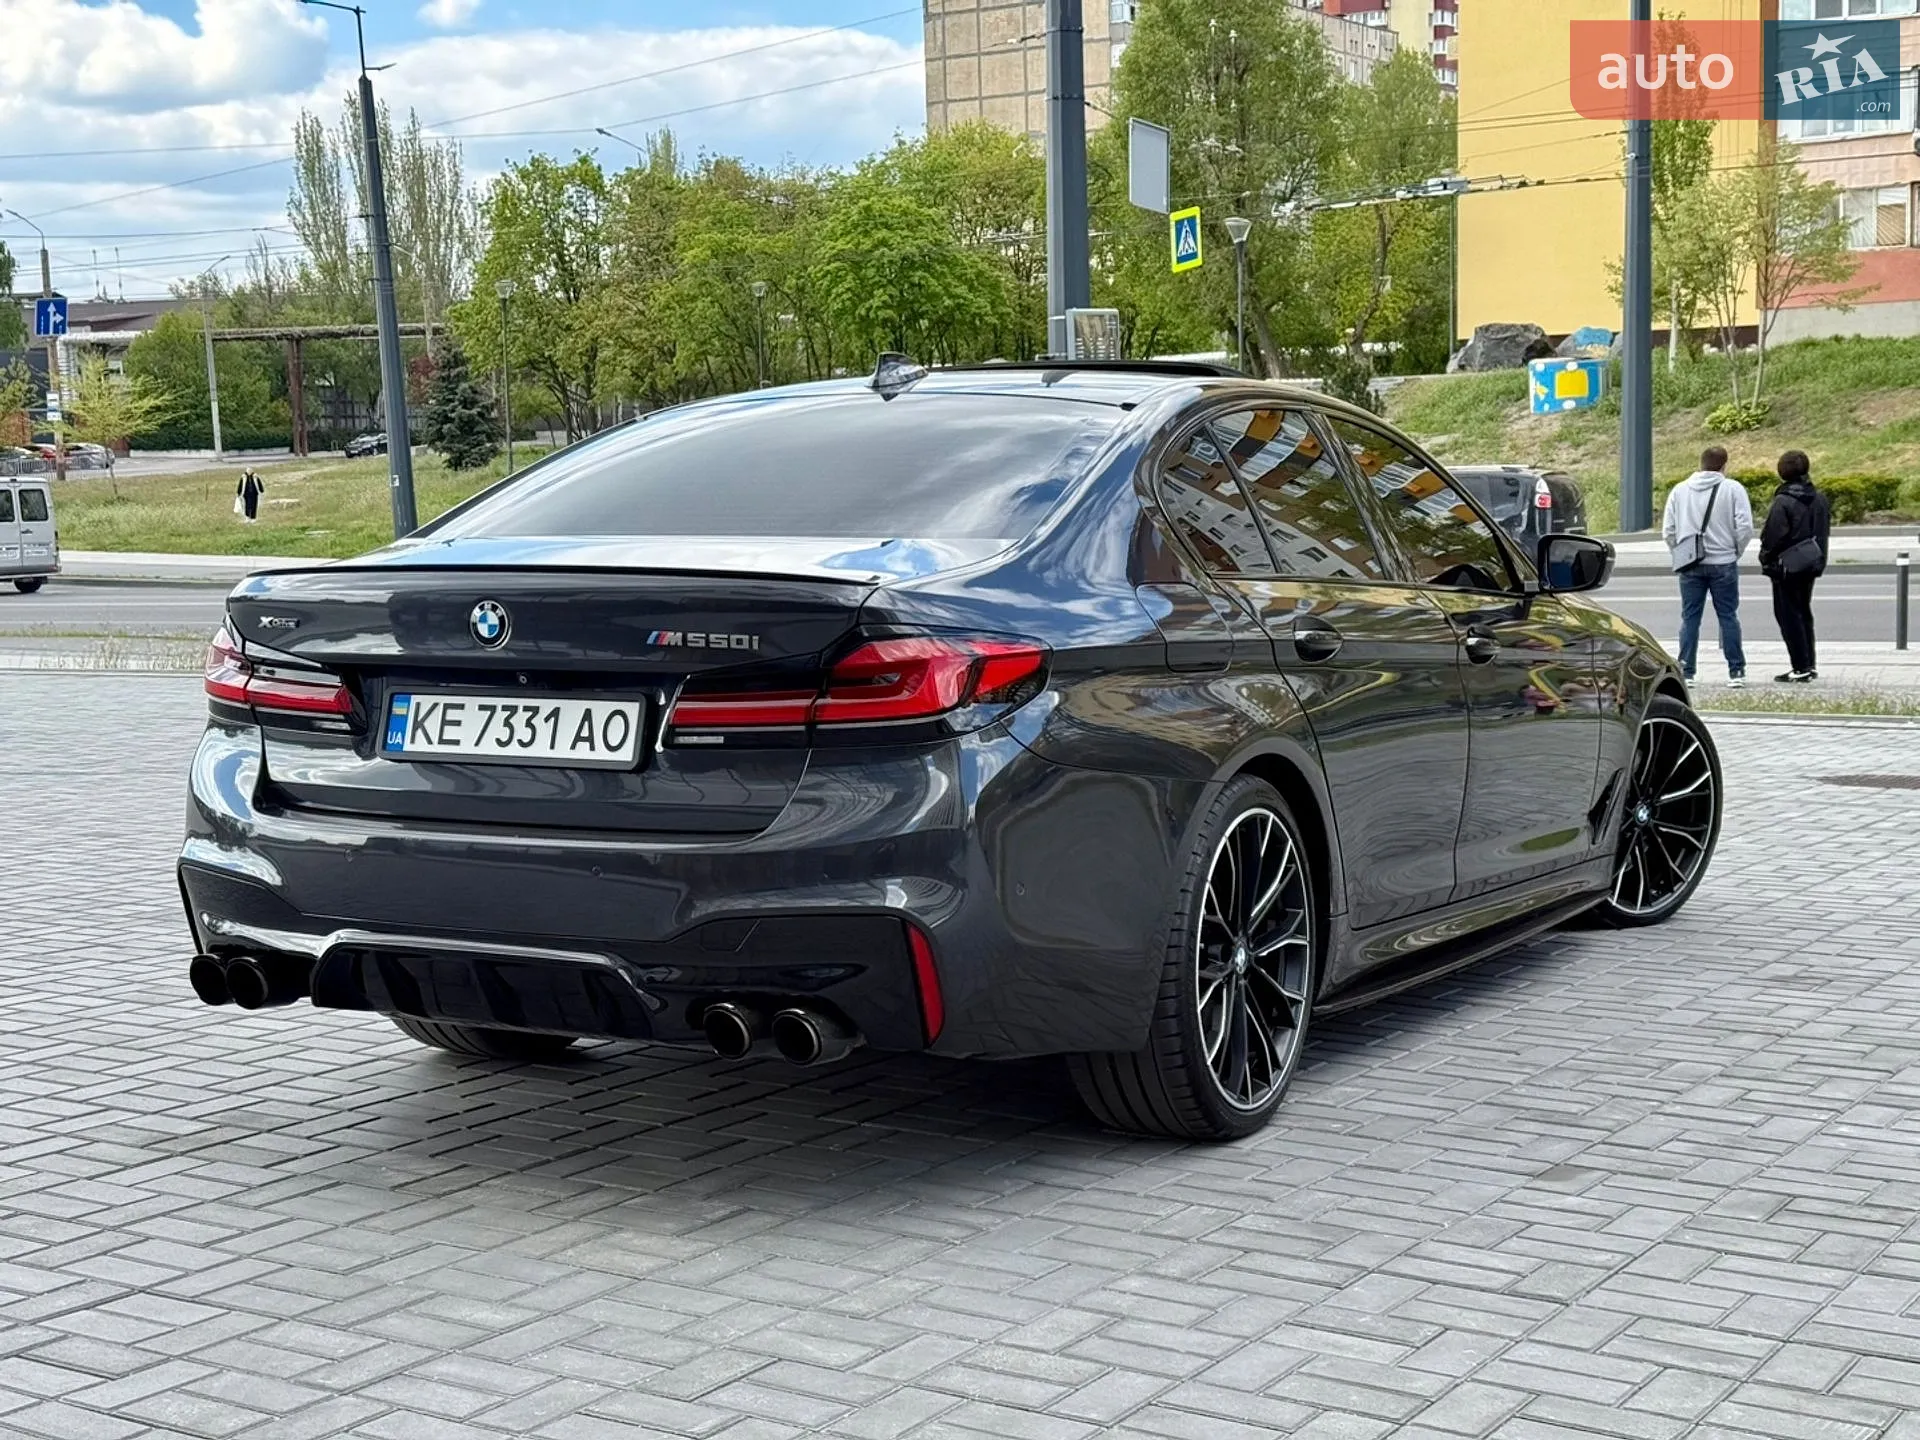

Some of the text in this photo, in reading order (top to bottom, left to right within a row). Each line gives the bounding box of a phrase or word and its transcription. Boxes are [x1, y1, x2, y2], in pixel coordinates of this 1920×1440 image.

[387, 731, 402, 744] UA
[410, 701, 630, 753] KE 7331 AO
